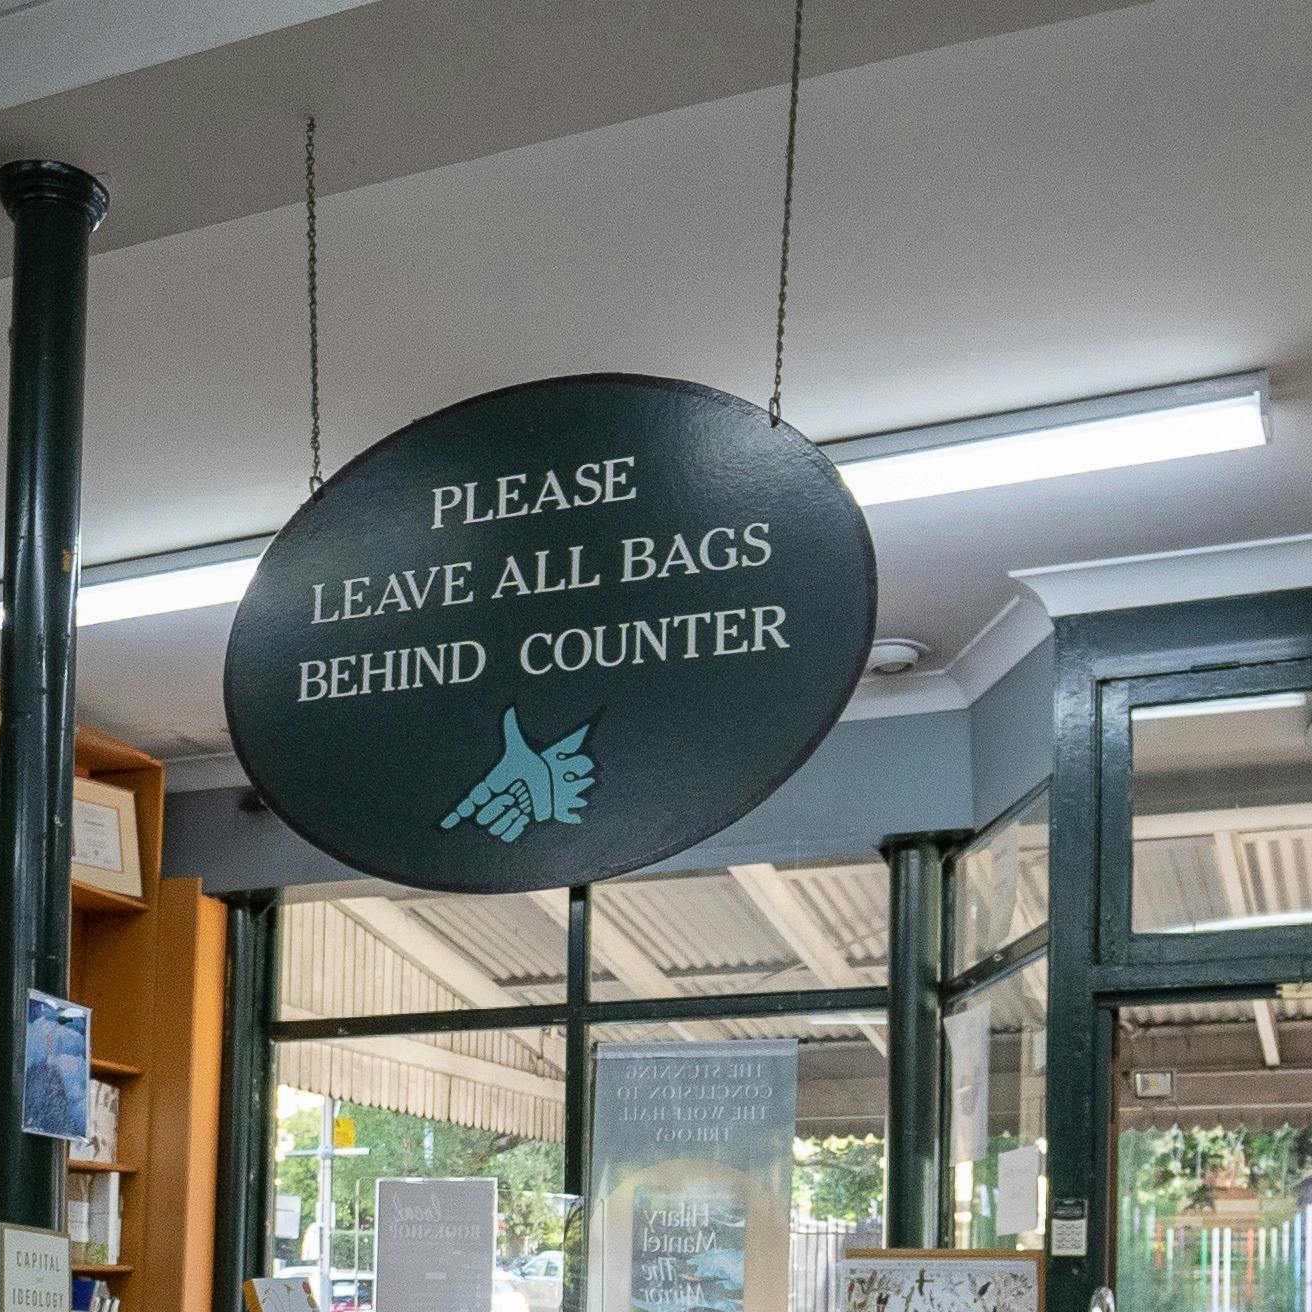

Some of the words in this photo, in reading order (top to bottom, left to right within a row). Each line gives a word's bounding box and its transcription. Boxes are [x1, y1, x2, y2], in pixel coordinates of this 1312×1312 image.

[431, 456, 638, 530] PLEASE
[311, 561, 475, 625] LEAVE
[491, 545, 601, 599] ALL
[620, 522, 773, 583] BAGS
[297, 640, 487, 702] BEHIND
[519, 604, 791, 676] COUNTER
[16, 1250, 61, 1273] CAPITAL
[12, 1288, 65, 1310] IDEOLOGY
